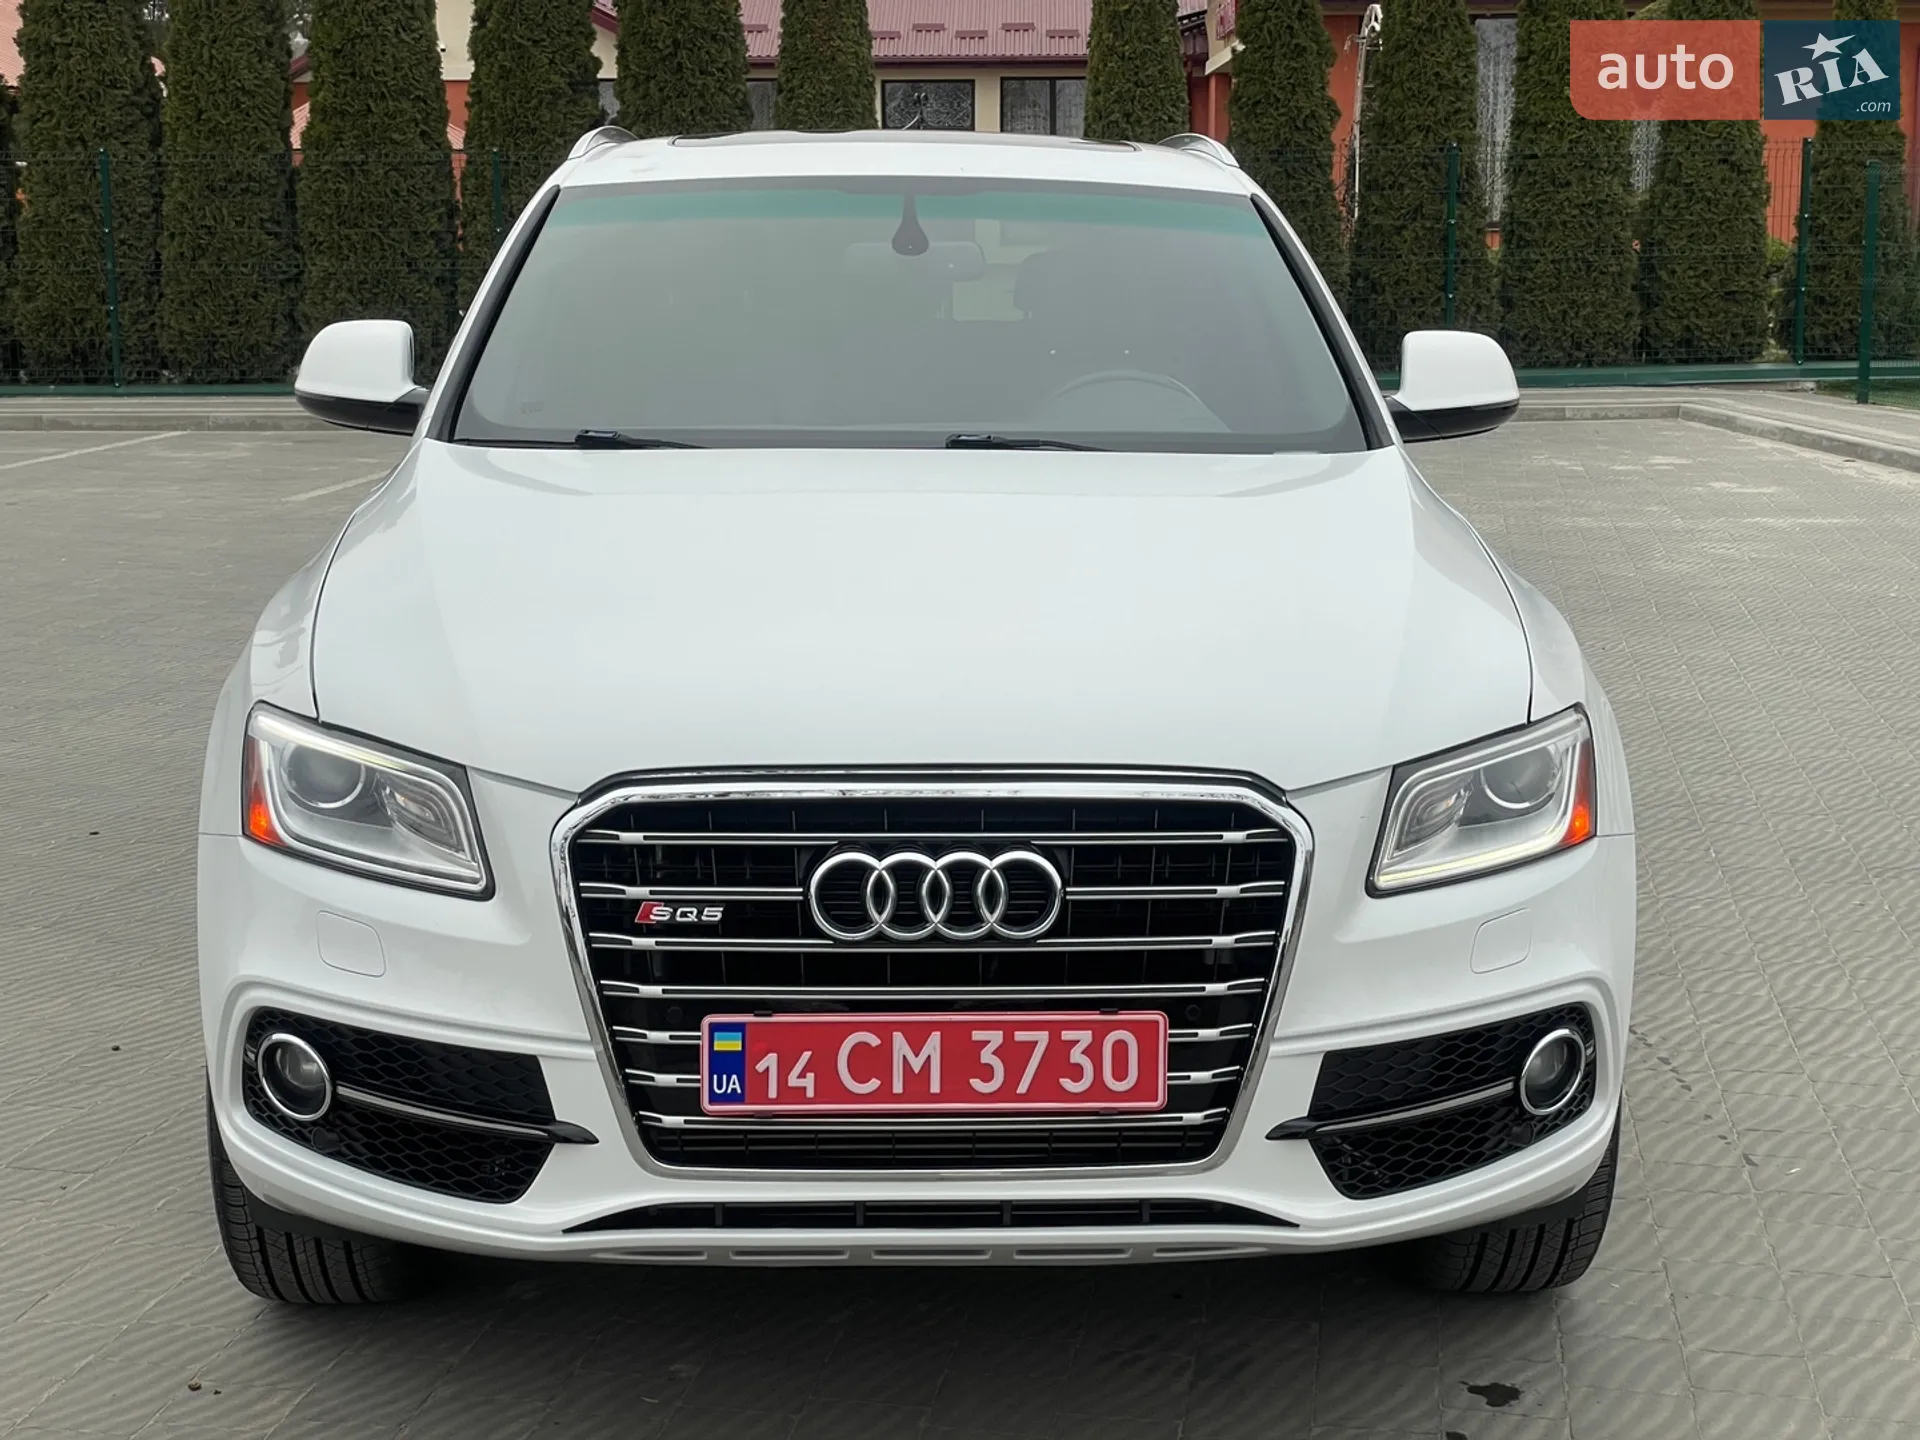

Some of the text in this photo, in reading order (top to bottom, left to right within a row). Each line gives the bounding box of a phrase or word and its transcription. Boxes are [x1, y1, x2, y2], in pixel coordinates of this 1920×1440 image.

[649, 906, 724, 922] SQ5
[755, 1029, 1139, 1098] 14 CM 3730
[712, 1073, 742, 1095] UA
